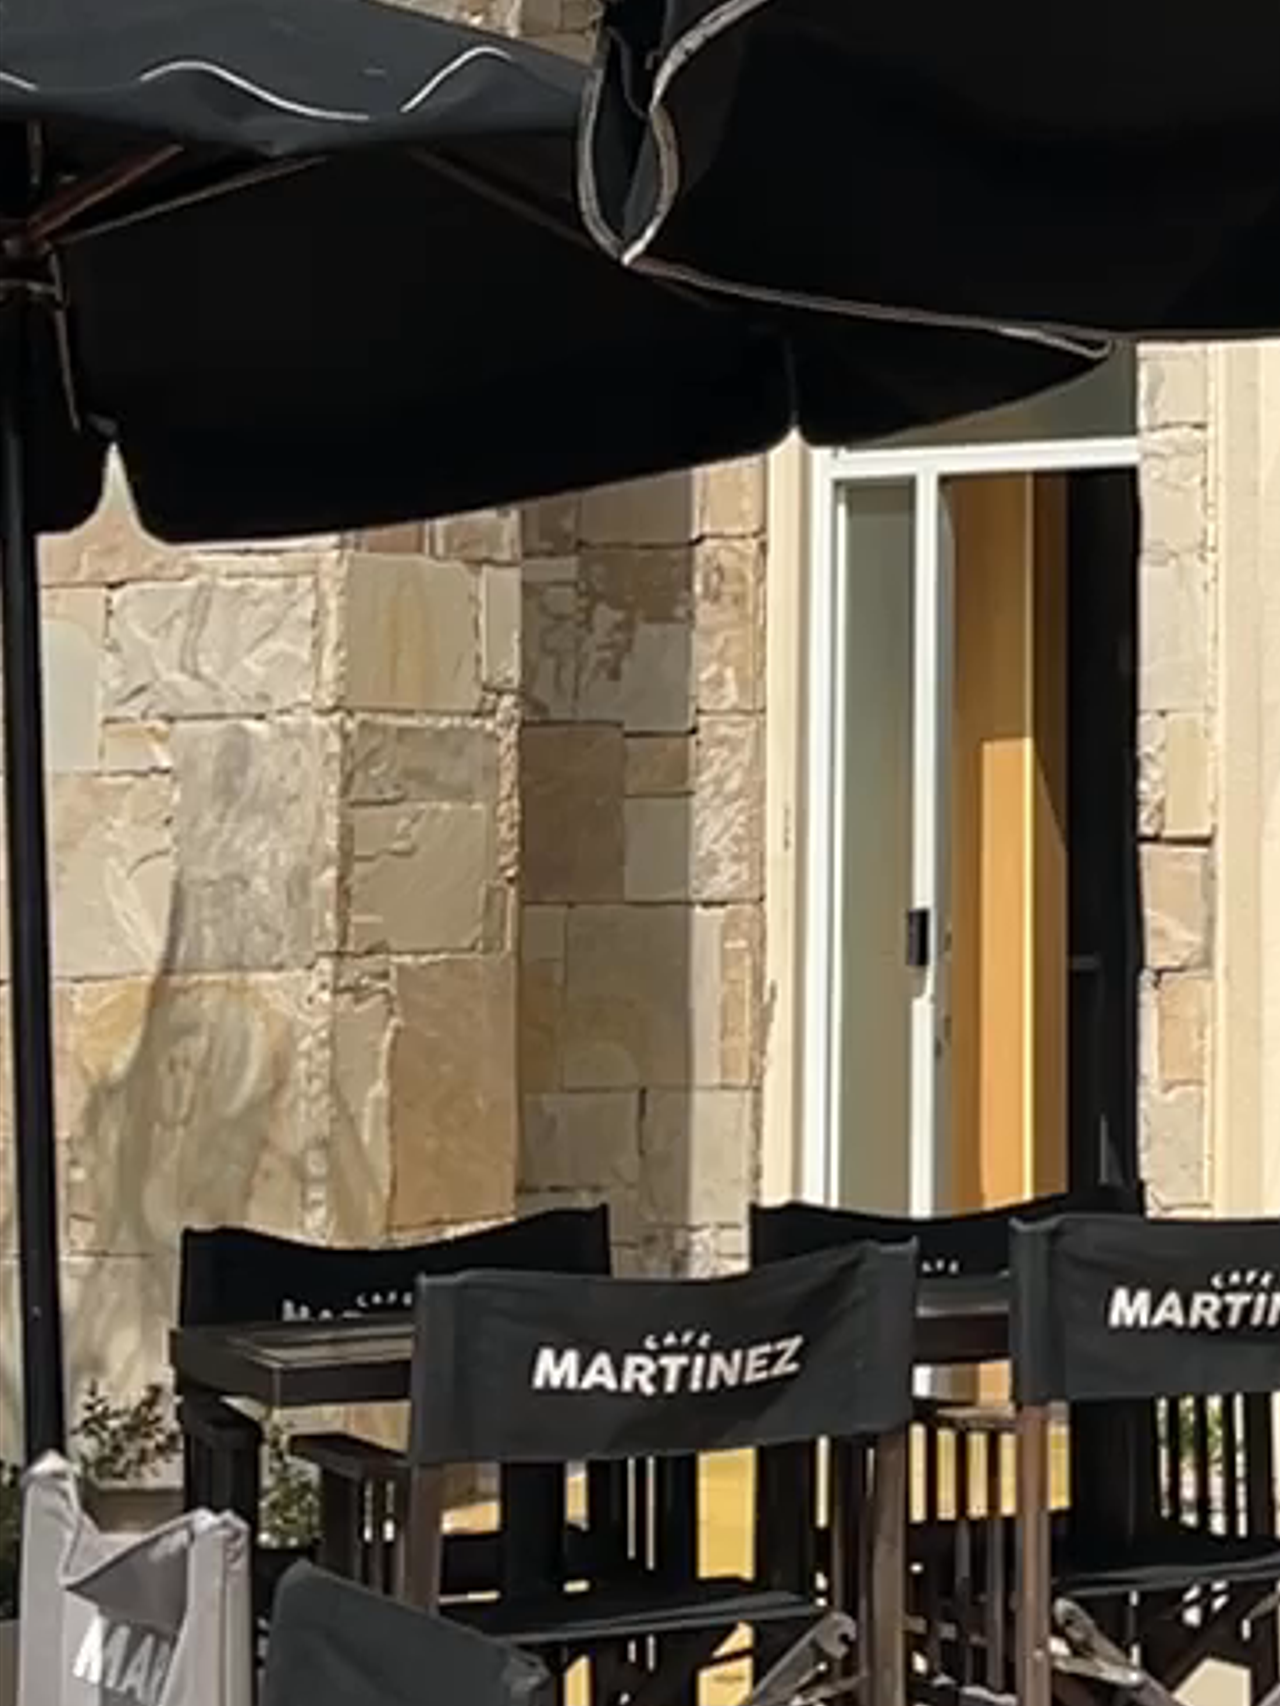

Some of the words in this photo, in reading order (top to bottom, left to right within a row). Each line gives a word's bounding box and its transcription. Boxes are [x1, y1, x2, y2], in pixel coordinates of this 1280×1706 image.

[1211, 1269, 1274, 1289] CAFE
[643, 1330, 712, 1351] CAFE
[532, 1334, 804, 1396] MARTINEZ
